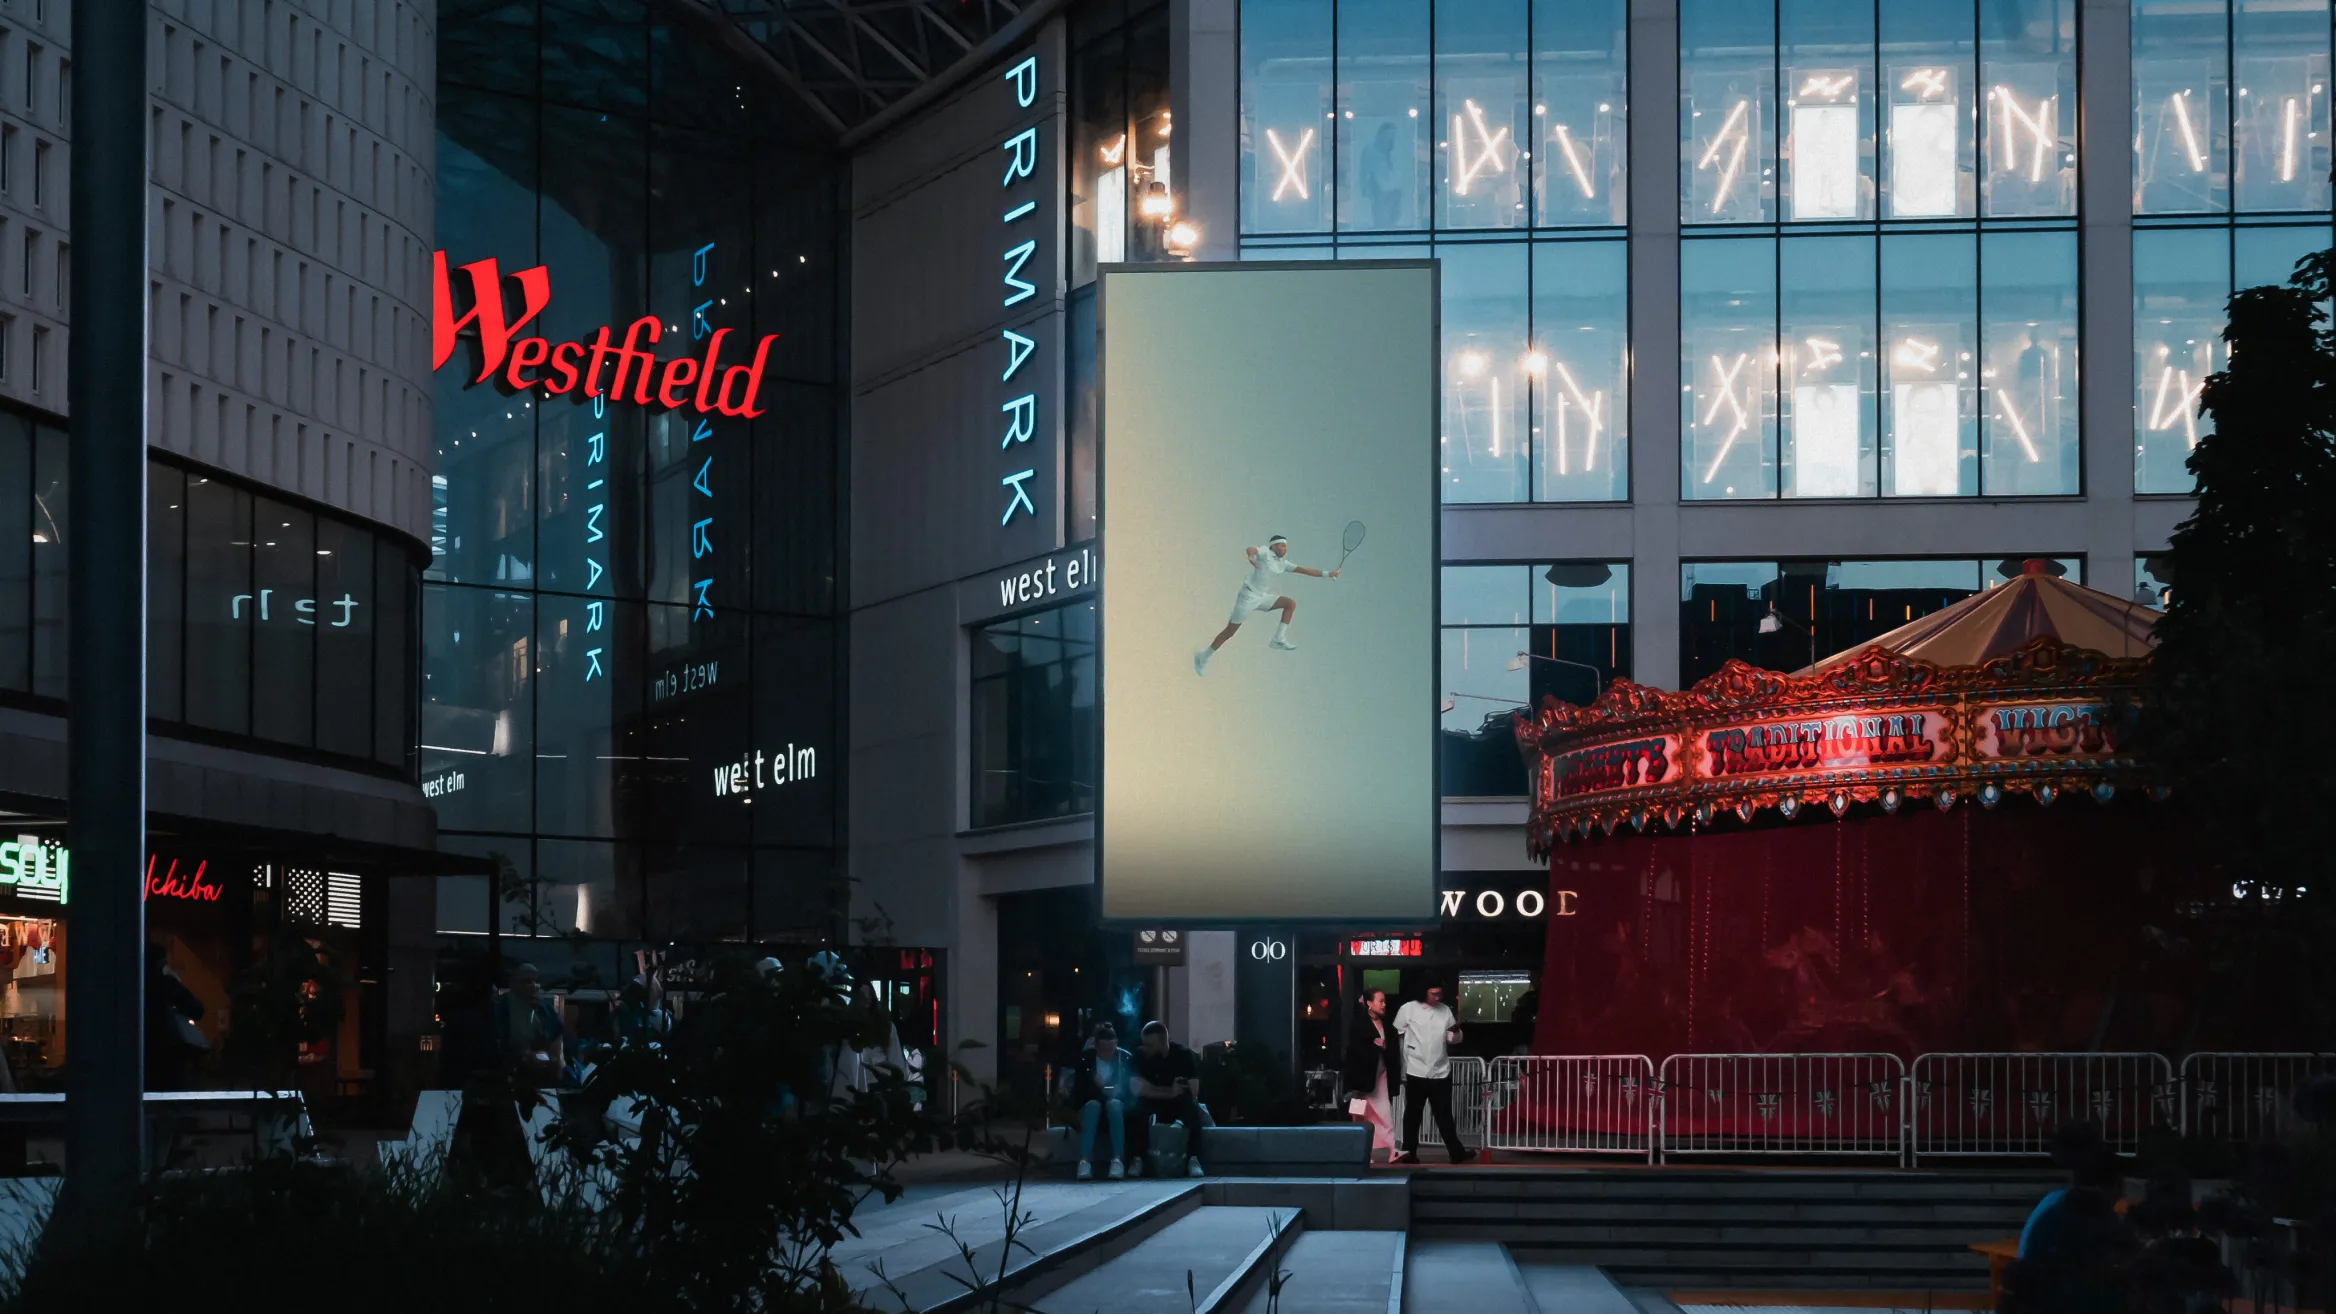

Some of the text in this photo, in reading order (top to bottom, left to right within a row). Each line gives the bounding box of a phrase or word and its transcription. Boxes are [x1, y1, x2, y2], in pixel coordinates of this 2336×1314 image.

[1002, 56, 1036, 526] PRIMARK
[432, 249, 781, 419] Westfield
[1000, 549, 1097, 607] west el
[773, 742, 816, 785] elm
[1707, 713, 1934, 776] TRADITIONAL
[422, 770, 465, 798] west elm
